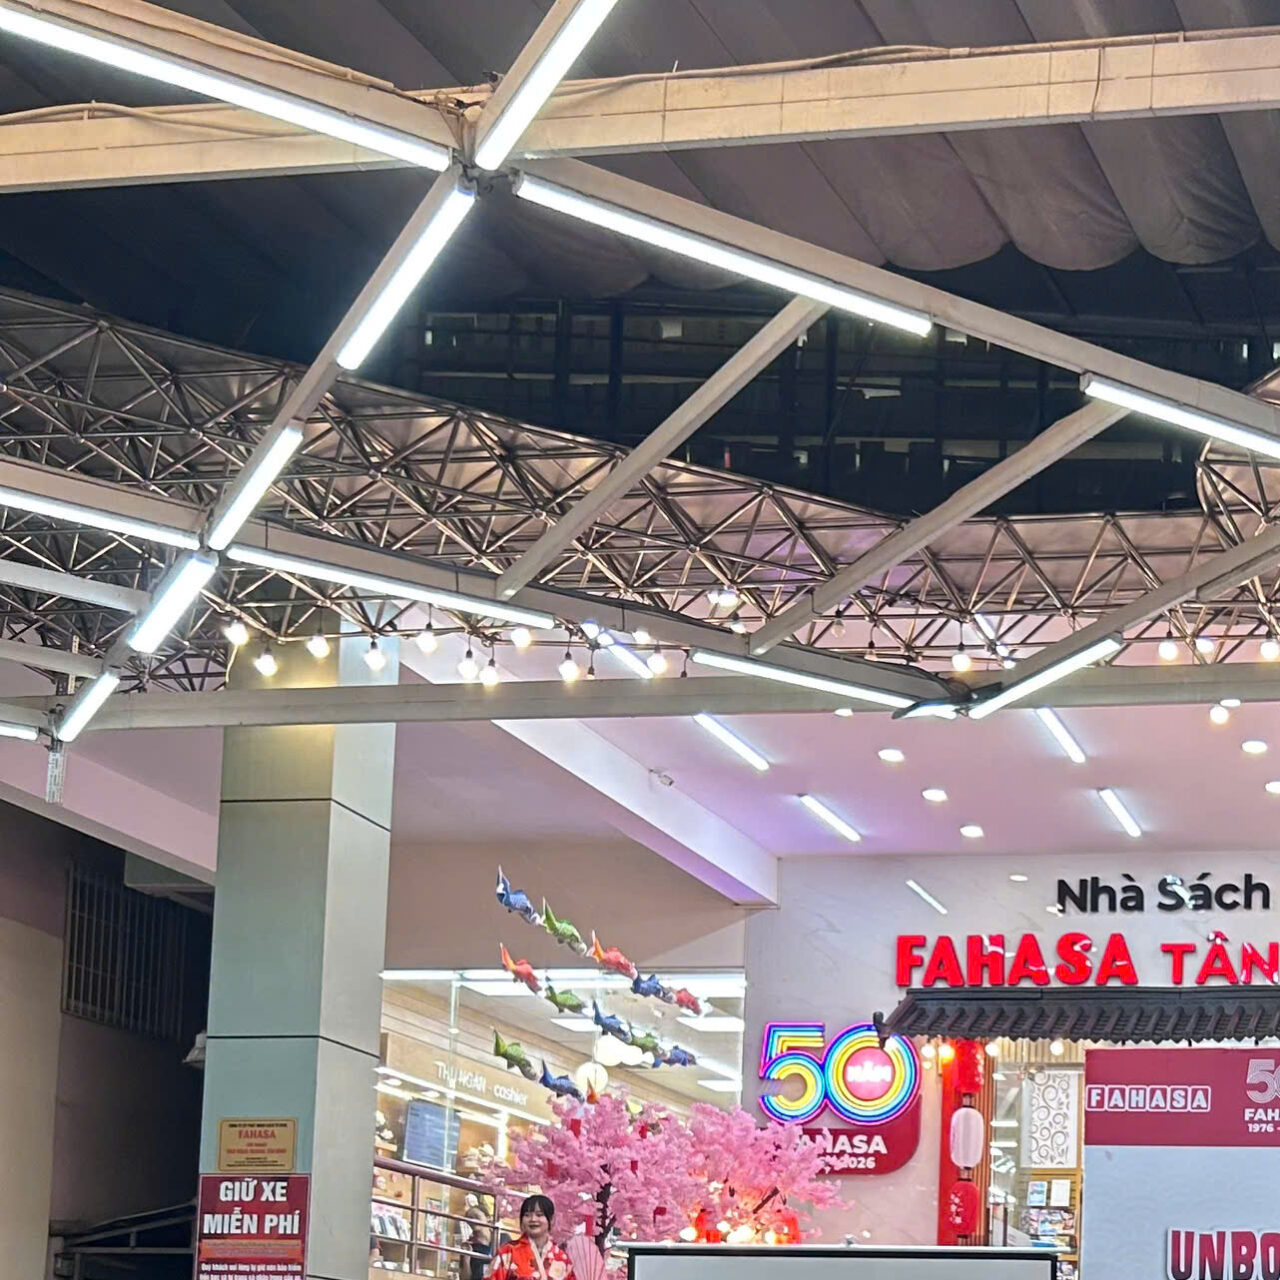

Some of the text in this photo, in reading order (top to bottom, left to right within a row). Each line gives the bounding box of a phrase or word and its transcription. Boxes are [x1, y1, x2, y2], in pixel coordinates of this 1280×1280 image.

[1056, 873, 1271, 913] Nhà Sách
[896, 933, 1138, 987] FAHASA
[1161, 930, 1279, 985] TÂN
[758, 1021, 922, 1127] 50
[493, 1084, 527, 1105] cashier
[1088, 1087, 1209, 1110] FAHASA
[1248, 1123, 1274, 1133] 1976
[219, 1178, 288, 1201] GIỮ XE
[203, 1207, 300, 1234] MIỄN PHÍ
